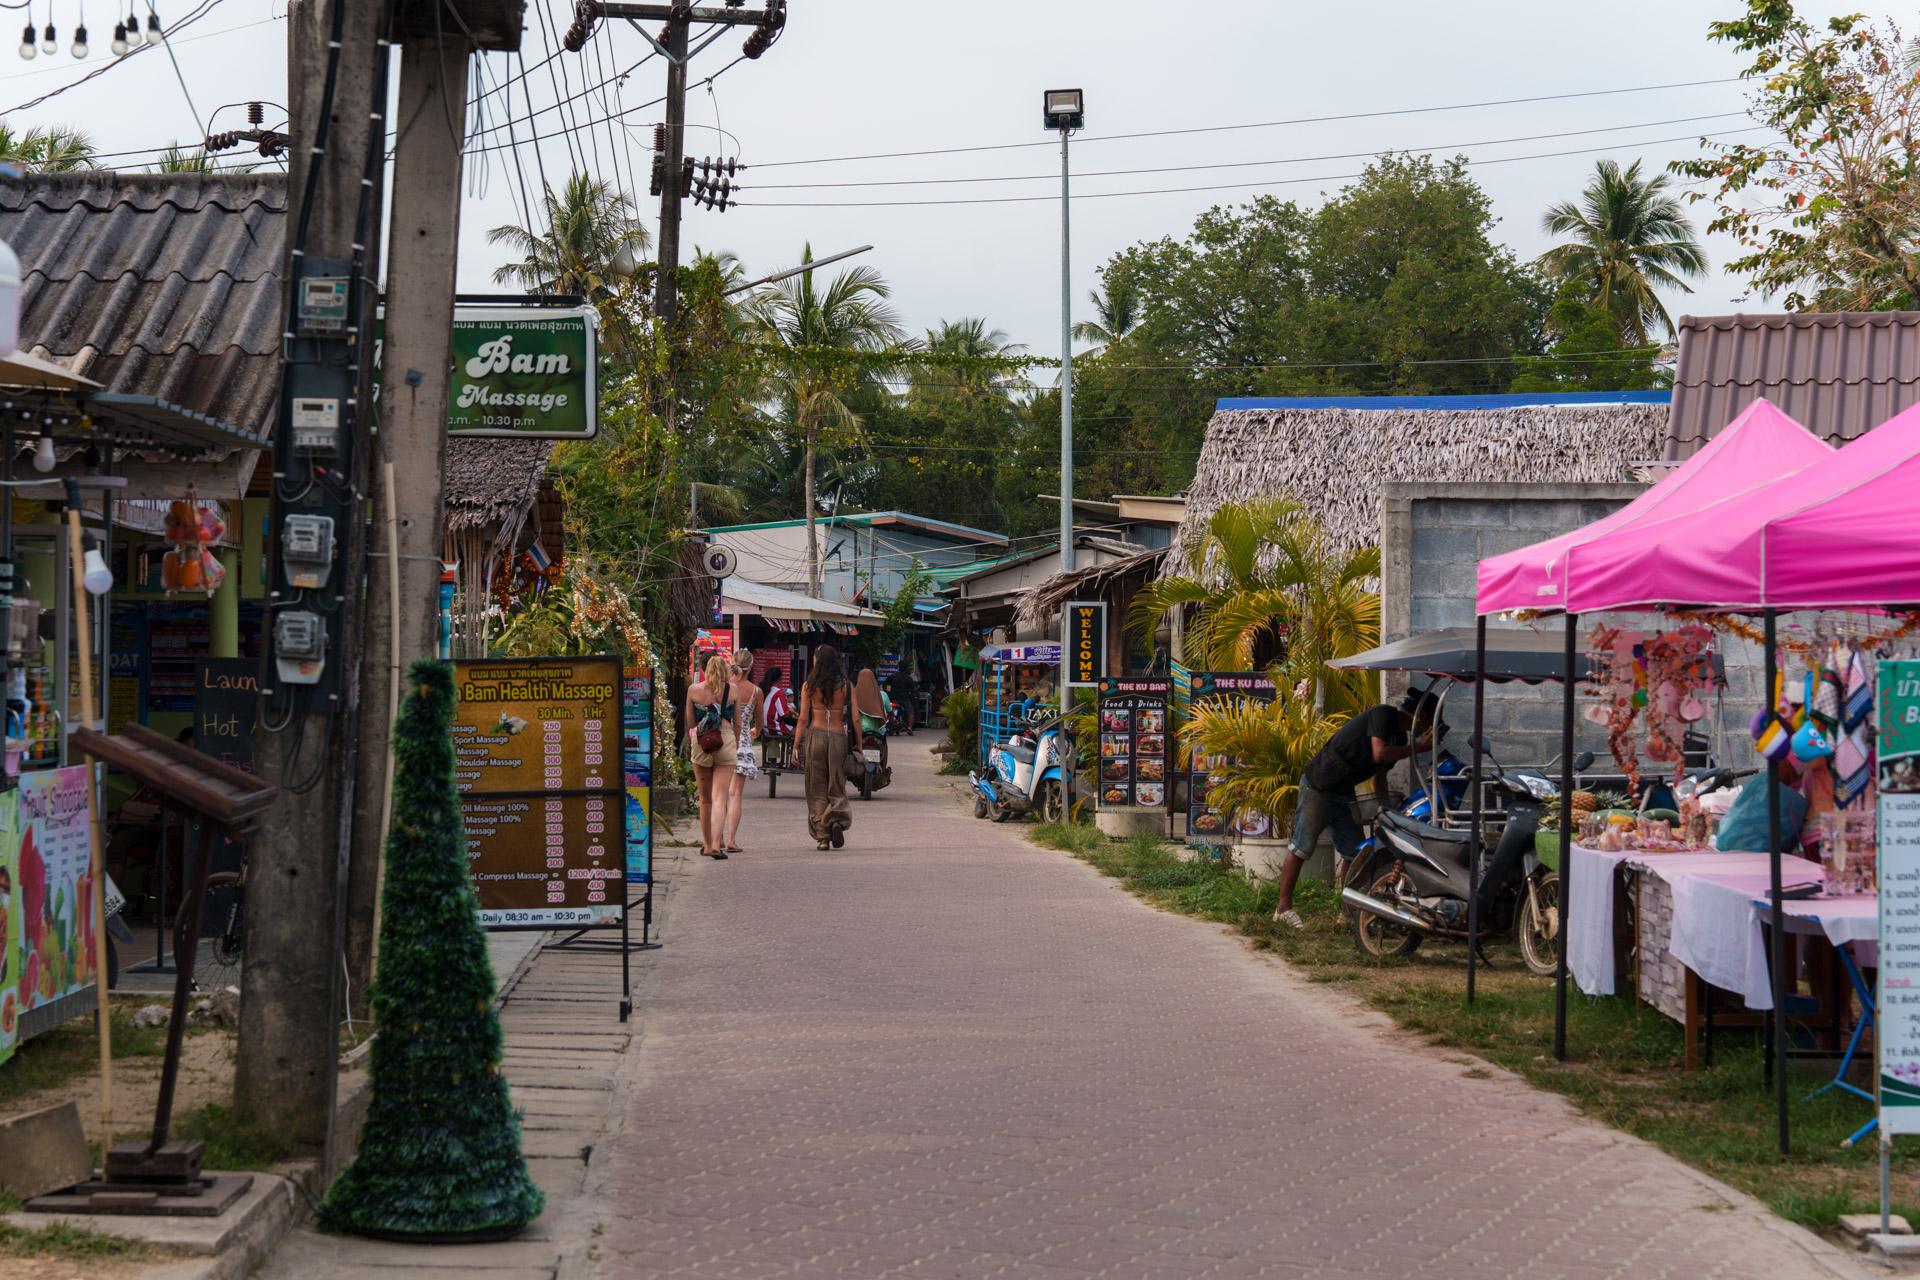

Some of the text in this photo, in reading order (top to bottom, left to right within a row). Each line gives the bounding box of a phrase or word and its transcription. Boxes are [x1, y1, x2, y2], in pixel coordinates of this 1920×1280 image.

[465, 335, 571, 379] Bam
[457, 384, 568, 412] Massage
[483, 415, 510, 425] 10.30
[513, 417, 535, 428] p.m
[1079, 608, 1095, 682] WELCOME
[204, 667, 258, 692] Laun
[1214, 679, 1235, 688] THE
[1237, 679, 1252, 688] KU
[465, 684, 497, 701] Bam
[500, 682, 549, 701] Health
[551, 681, 614, 703] Massage
[1117, 683, 1167, 691] THE KU BAR
[1104, 699, 1123, 708] Food
[1138, 699, 1162, 708] Drinks
[538, 708, 550, 718] 30
[553, 708, 573, 718] Min.
[592, 707, 605, 718] Hr.
[203, 712, 240, 737] Hot
[545, 722, 560, 731] 250
[585, 720, 601, 729] 400
[455, 732, 601, 744] Sport Massage 400 700
[457, 748, 489, 757] Massage
[585, 743, 601, 752] 500
[456, 759, 488, 767] Shoulder
[489, 759, 522, 767] Massage
[586, 755, 602, 764] 500
[586, 778, 602, 787] 500
[474, 805, 505, 814] Massage
[586, 801, 603, 810] 600
[466, 816, 497, 825] Massage
[587, 812, 603, 821] 600
[464, 828, 496, 836] Massage
[587, 823, 604, 832] 600
[547, 846, 604, 856] 250 400
[478, 872, 515, 881] Compress
[516, 872, 549, 881] Massage
[607, 869, 621, 878] min
[548, 881, 564, 890] 250
[548, 892, 564, 902] 250
[483, 914, 502, 923] Daily
[505, 912, 528, 921] 08:30
[555, 911, 575, 920] 10:30
[578, 913, 591, 922] pm
